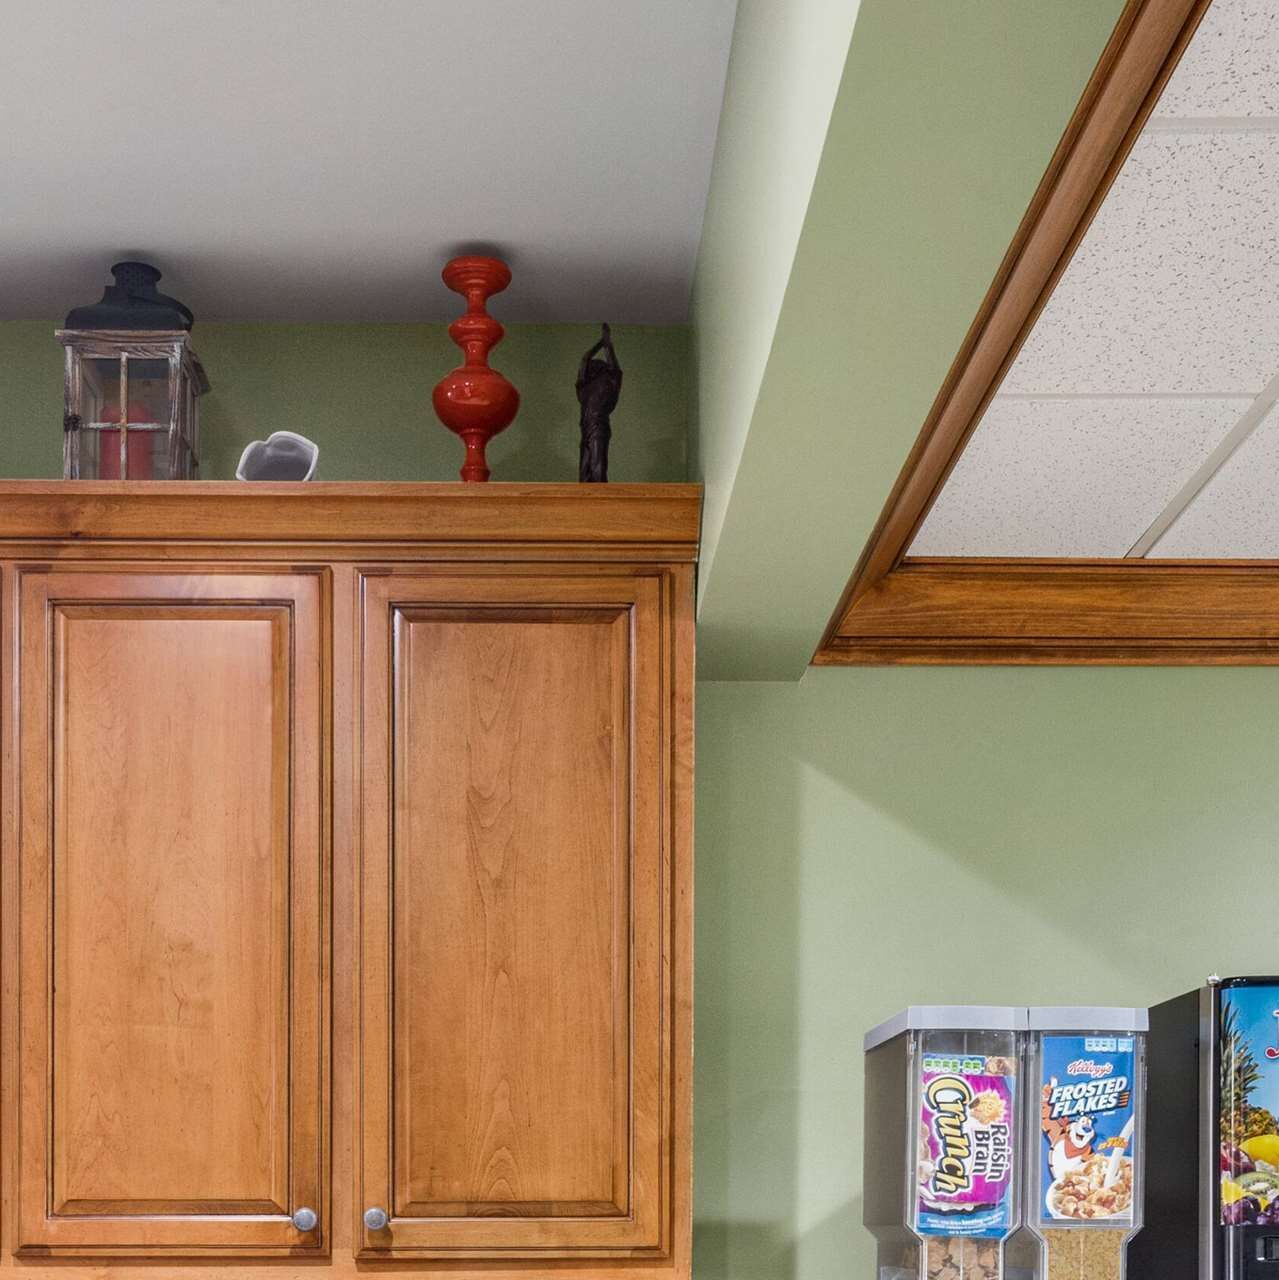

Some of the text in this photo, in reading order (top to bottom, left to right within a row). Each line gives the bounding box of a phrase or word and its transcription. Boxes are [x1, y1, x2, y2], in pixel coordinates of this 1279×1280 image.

[1050, 1076, 1127, 1104] FROSTED
[1051, 1093, 1118, 1118] FLAKES
[926, 1076, 971, 1193] Crunch
[972, 1130, 991, 1173] Bran
[988, 1124, 1009, 1181] Raisin
